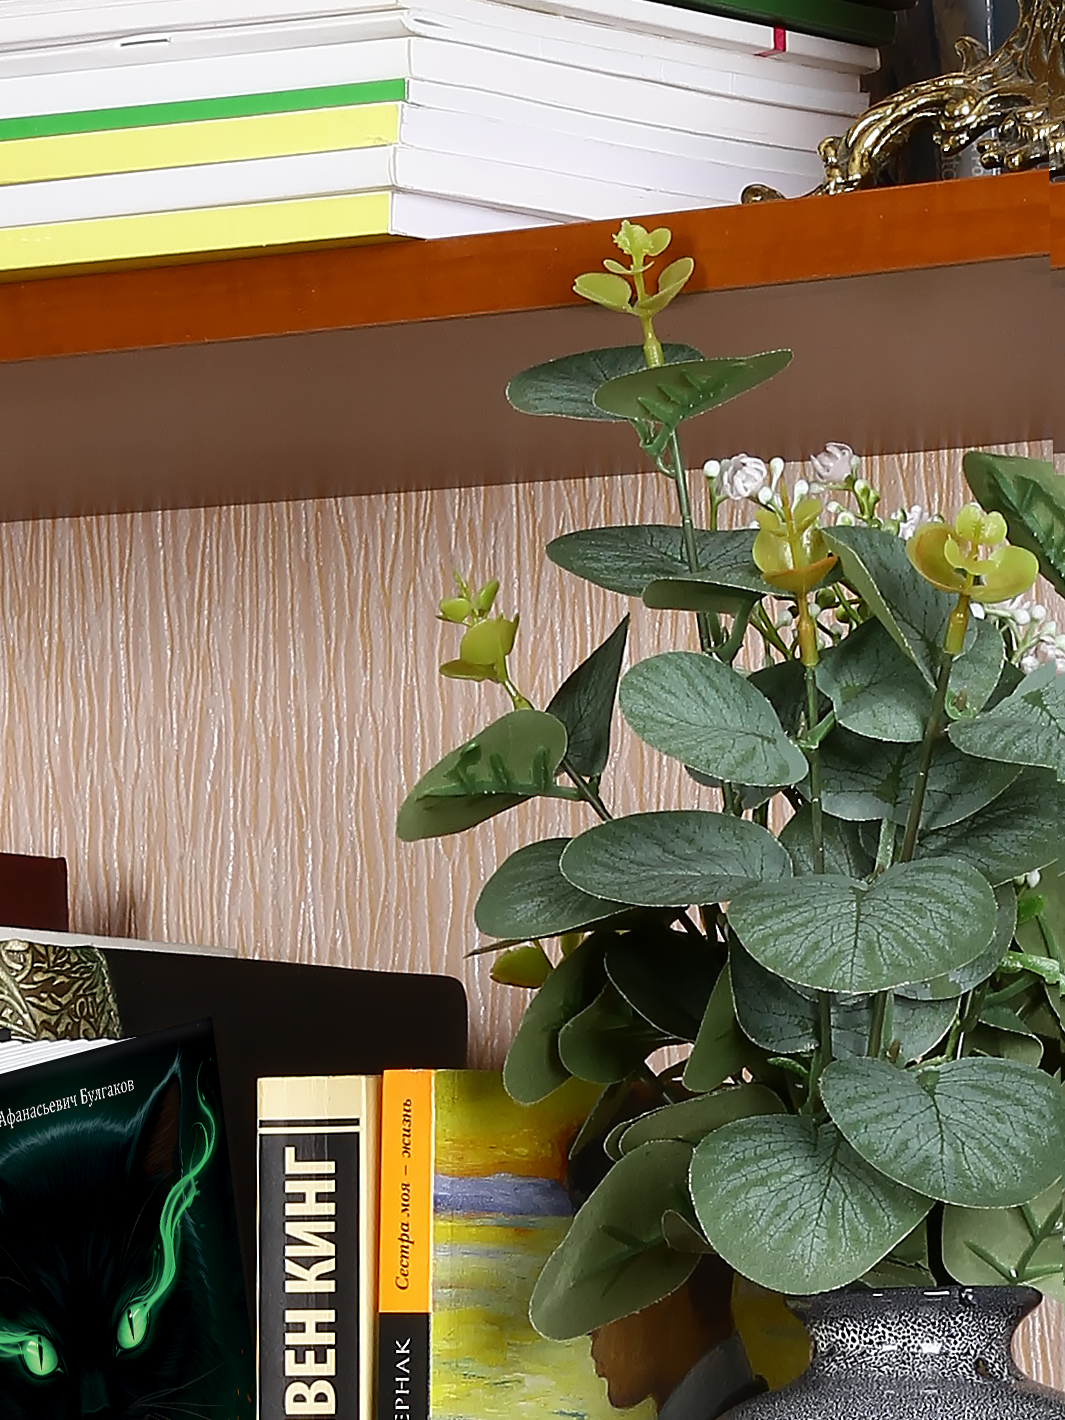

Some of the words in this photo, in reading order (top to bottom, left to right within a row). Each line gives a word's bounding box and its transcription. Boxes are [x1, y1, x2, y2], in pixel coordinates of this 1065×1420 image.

[79, 1079, 135, 1108] Булгаков
[401, 1098, 412, 1159] жизнь
[284, 1146, 336, 1294] КИНГ
[400, 1182, 411, 1218] моя
[394, 1222, 415, 1291] Сестра
